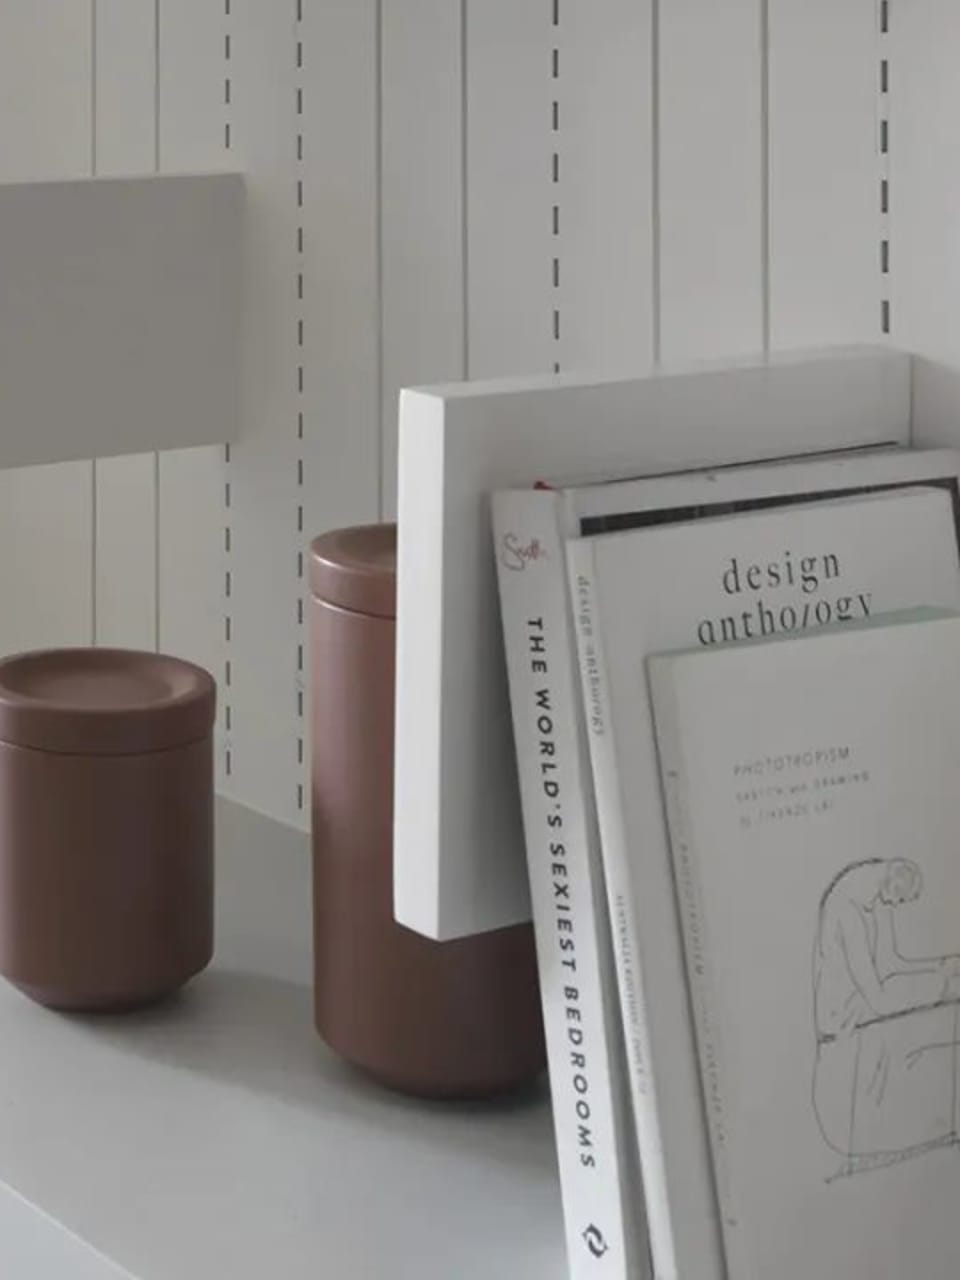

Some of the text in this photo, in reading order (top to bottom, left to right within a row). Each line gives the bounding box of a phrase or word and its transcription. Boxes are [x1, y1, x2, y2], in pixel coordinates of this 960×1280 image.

[723, 551, 840, 594] design
[527, 617, 596, 1168] THE WORLD'S SEXIEST BEDROOMS
